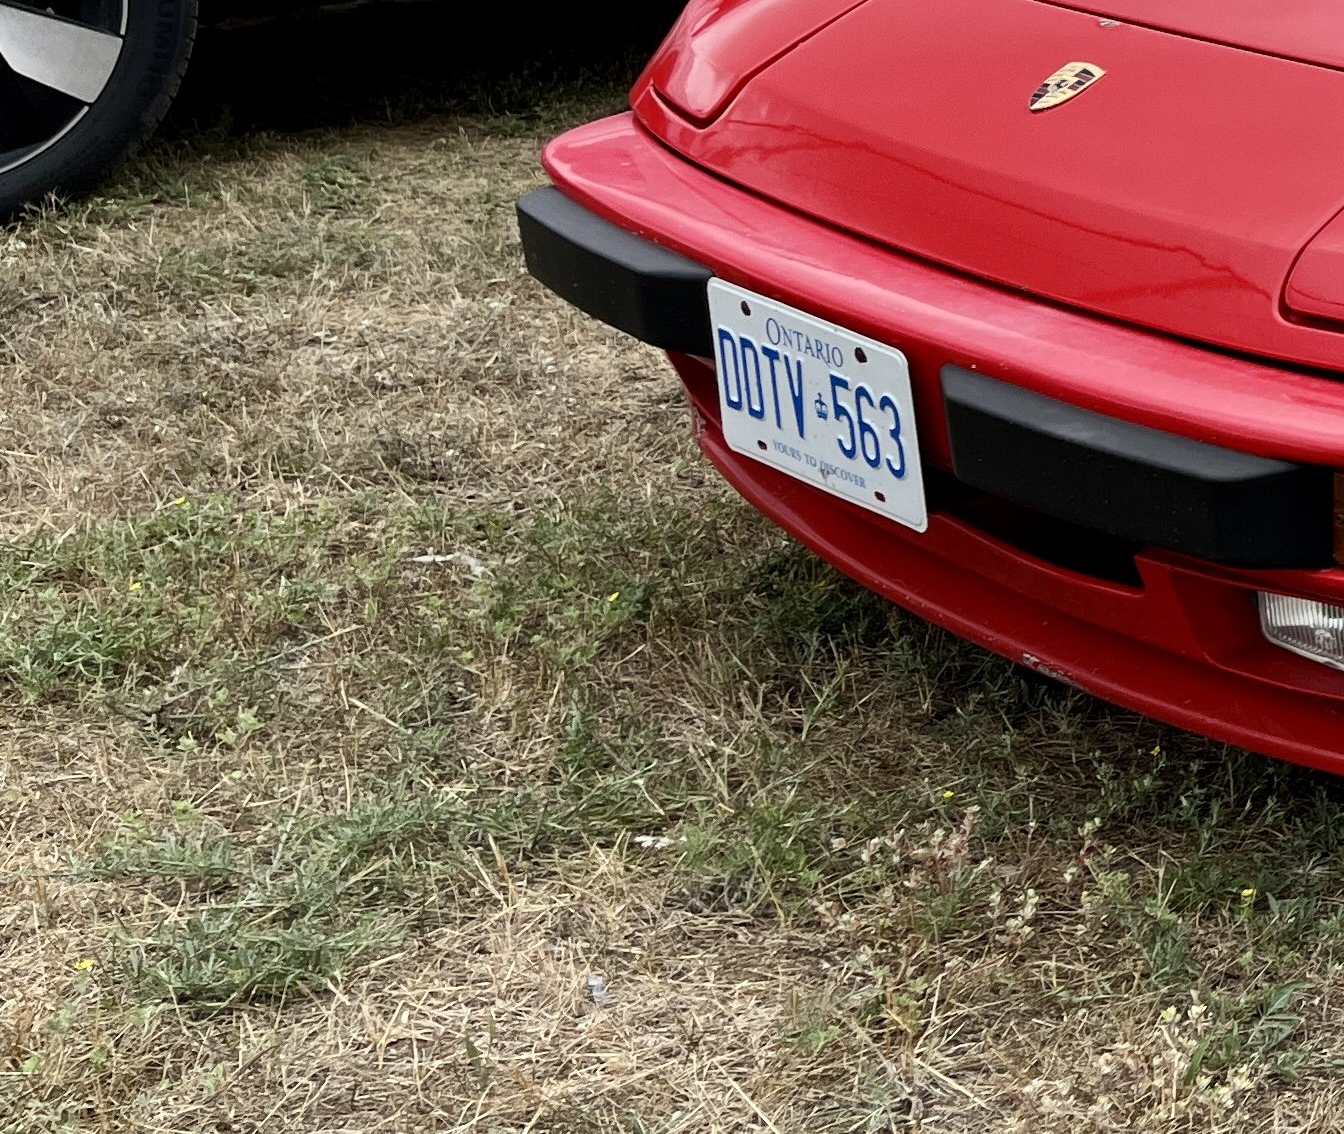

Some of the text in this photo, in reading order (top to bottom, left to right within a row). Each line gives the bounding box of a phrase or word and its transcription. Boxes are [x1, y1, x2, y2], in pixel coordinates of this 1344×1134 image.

[765, 317, 844, 367] ONTARIO
[718, 326, 906, 480] DDTV 563
[772, 439, 867, 488] YOURS TO DISCOVER
